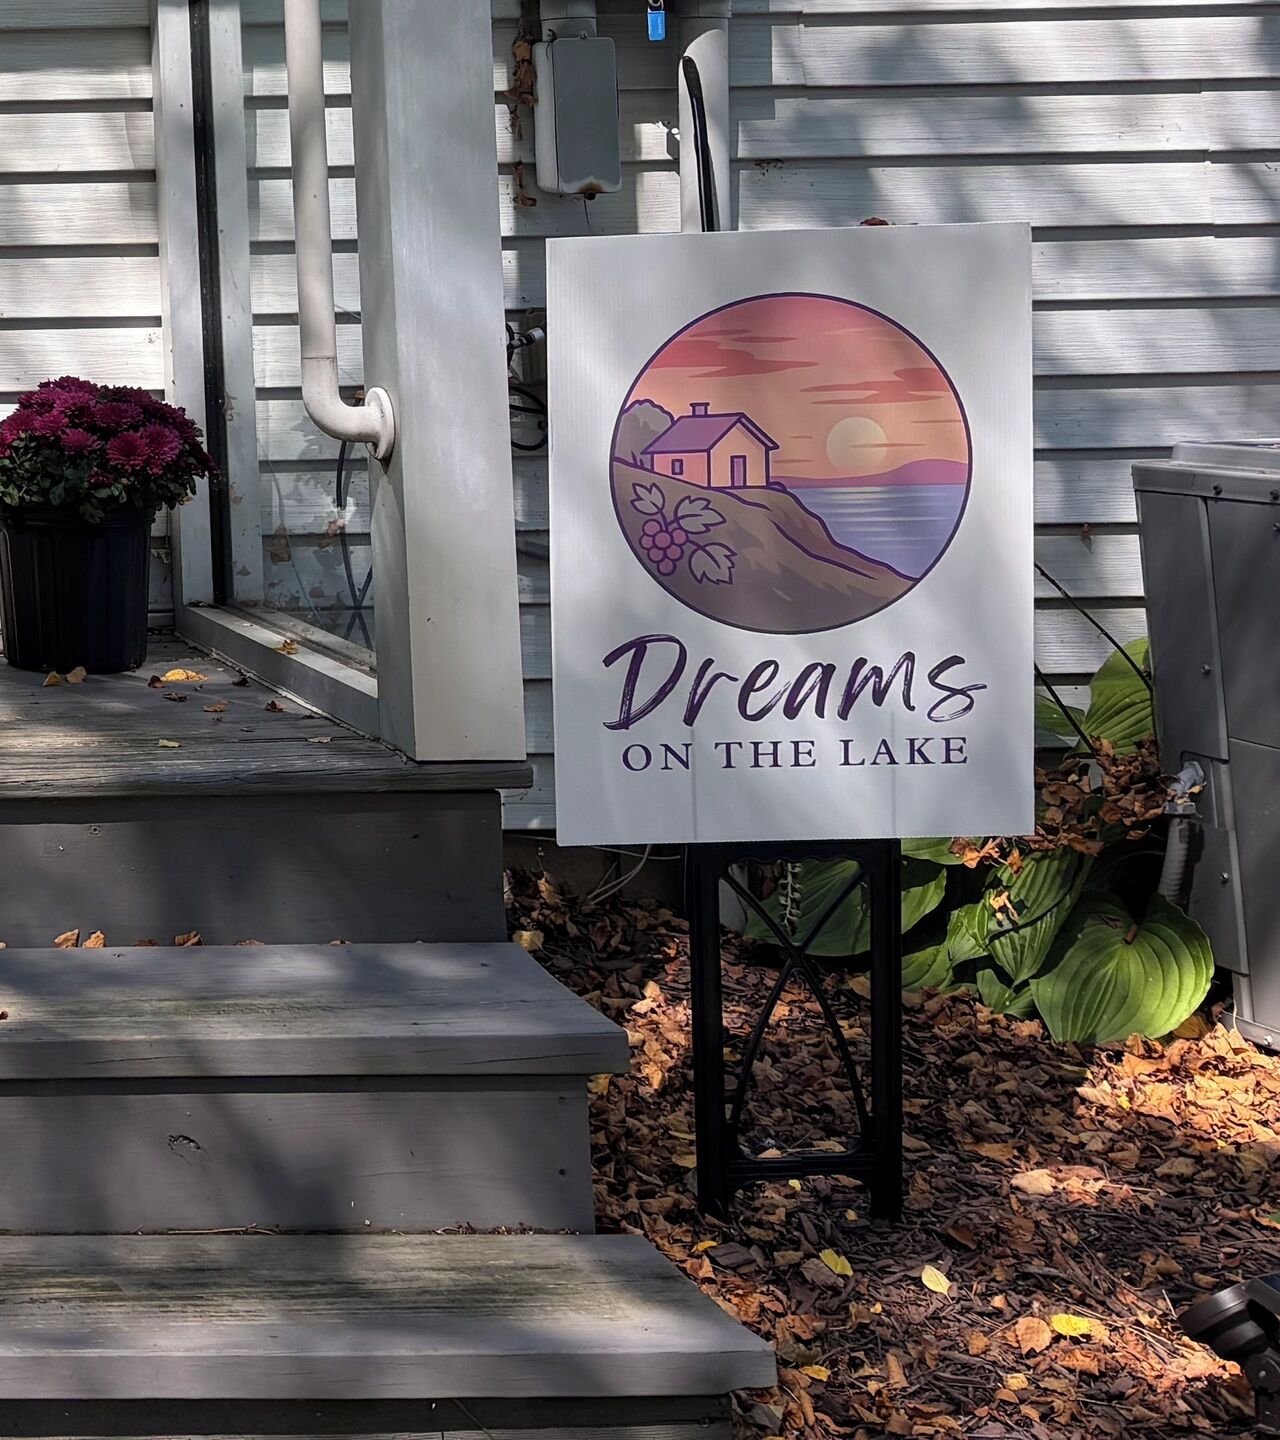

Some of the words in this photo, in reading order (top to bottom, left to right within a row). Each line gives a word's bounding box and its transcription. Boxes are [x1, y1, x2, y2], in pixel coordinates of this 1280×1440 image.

[602, 633, 988, 731] Dreams
[621, 742, 692, 772] ON
[714, 739, 818, 769] THE
[839, 736, 969, 767] LAKE
